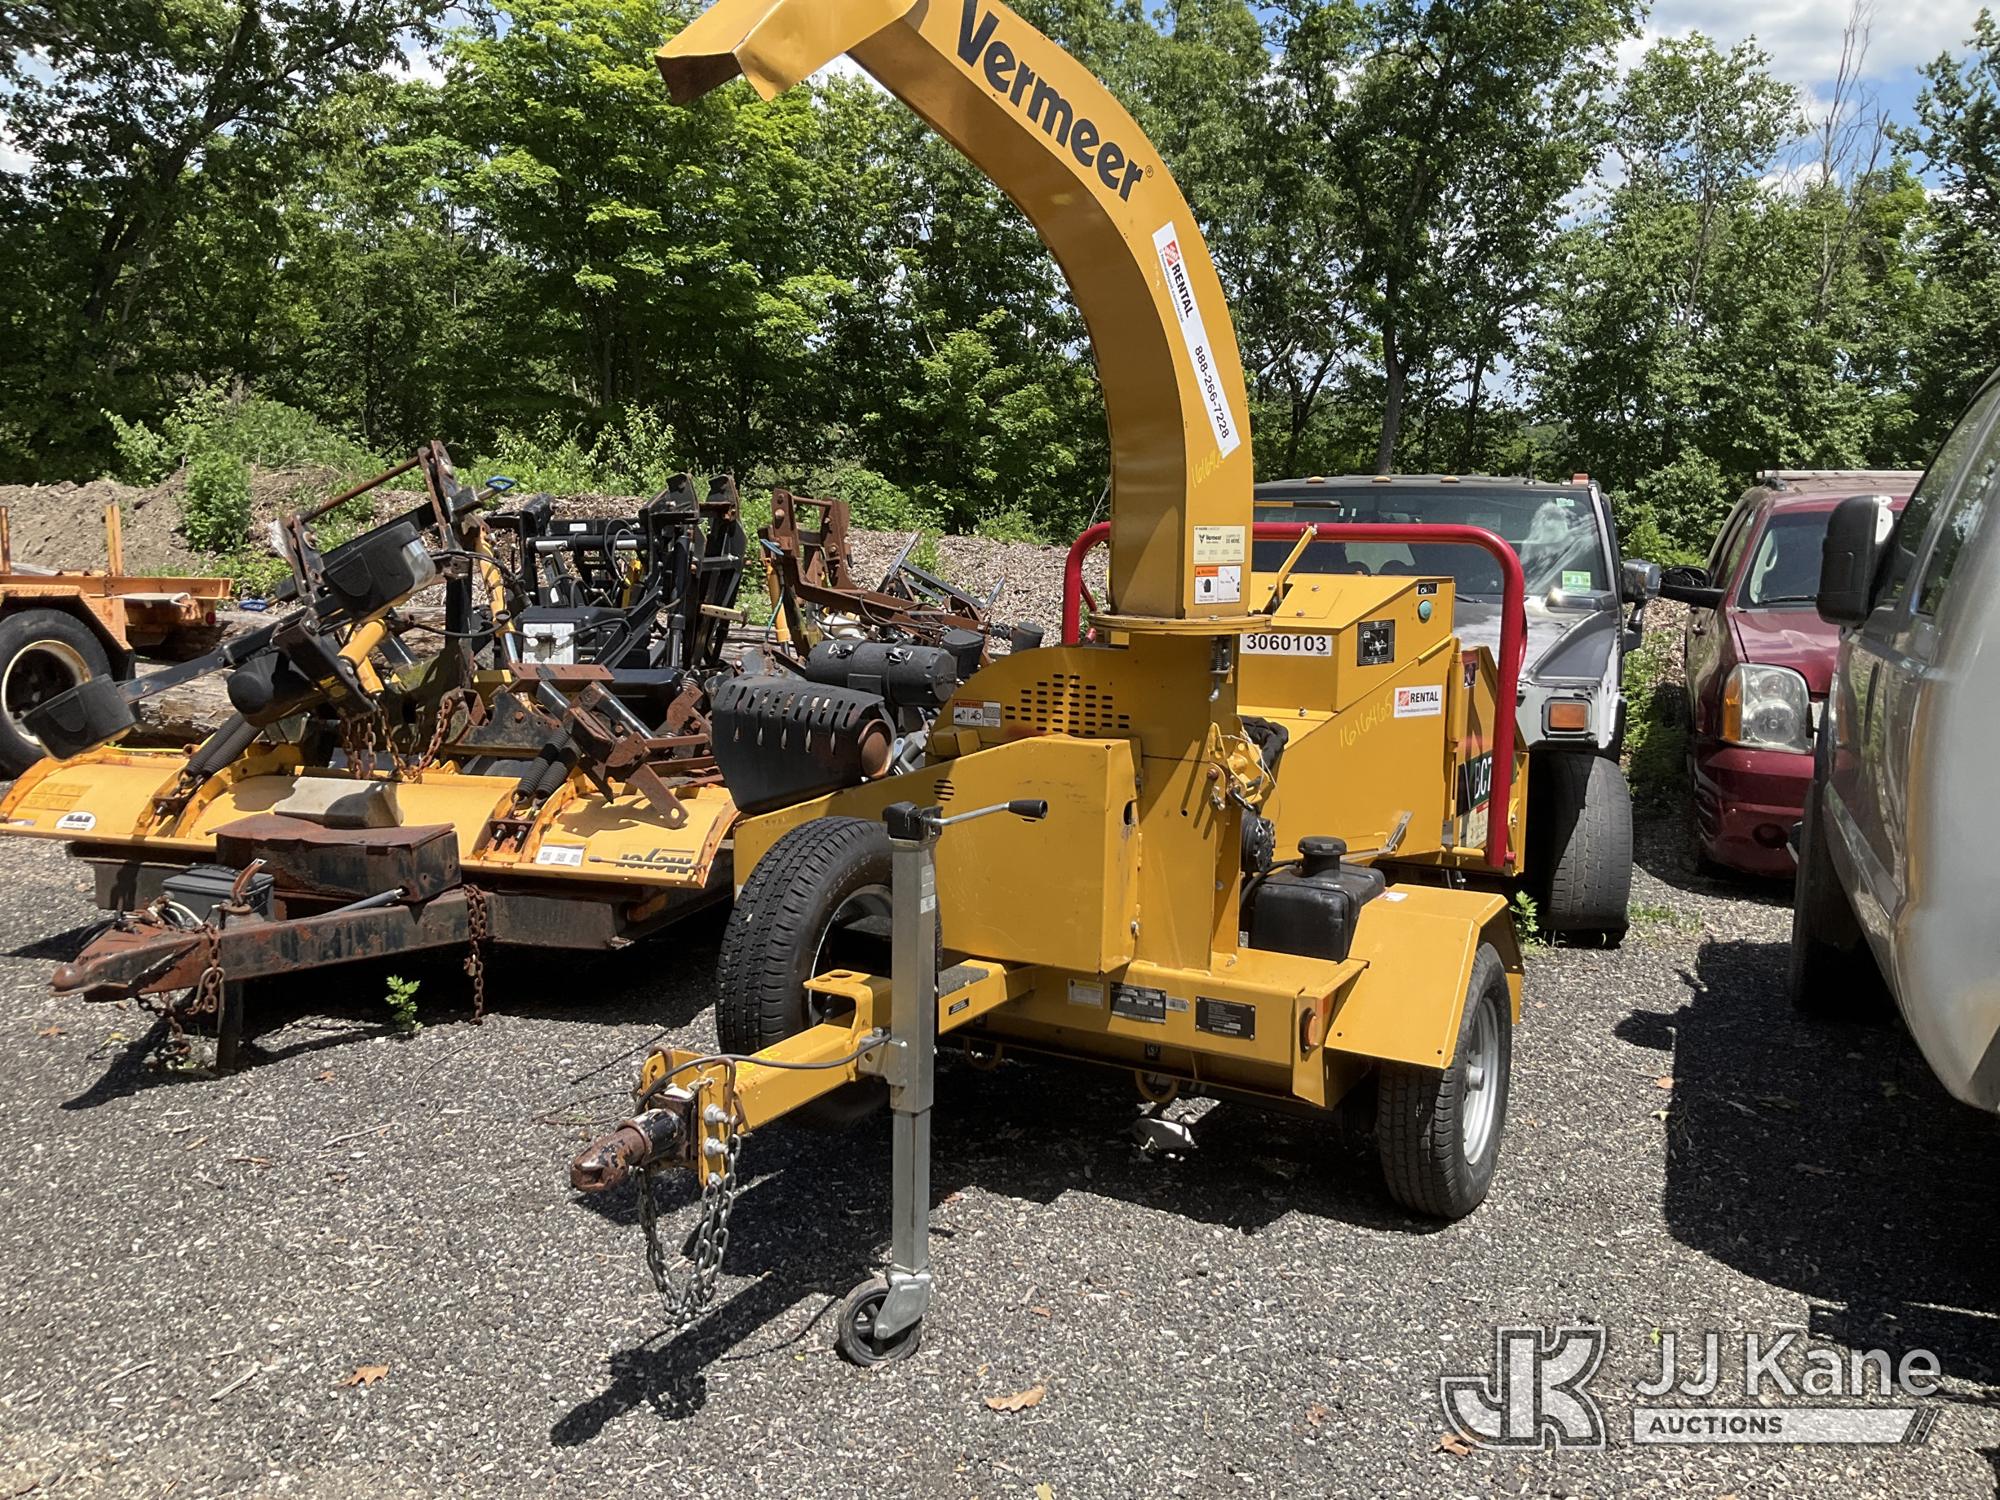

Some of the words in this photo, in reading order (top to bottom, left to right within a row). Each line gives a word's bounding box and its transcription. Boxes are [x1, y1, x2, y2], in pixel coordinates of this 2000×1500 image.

[957, 0, 1144, 202] Vermeer
[1171, 263, 1194, 318] RENTAL
[1194, 345, 1230, 439] 888-266-7228
[1246, 634, 1327, 652] 3060103
[1410, 691, 1439, 703] RENTAL
